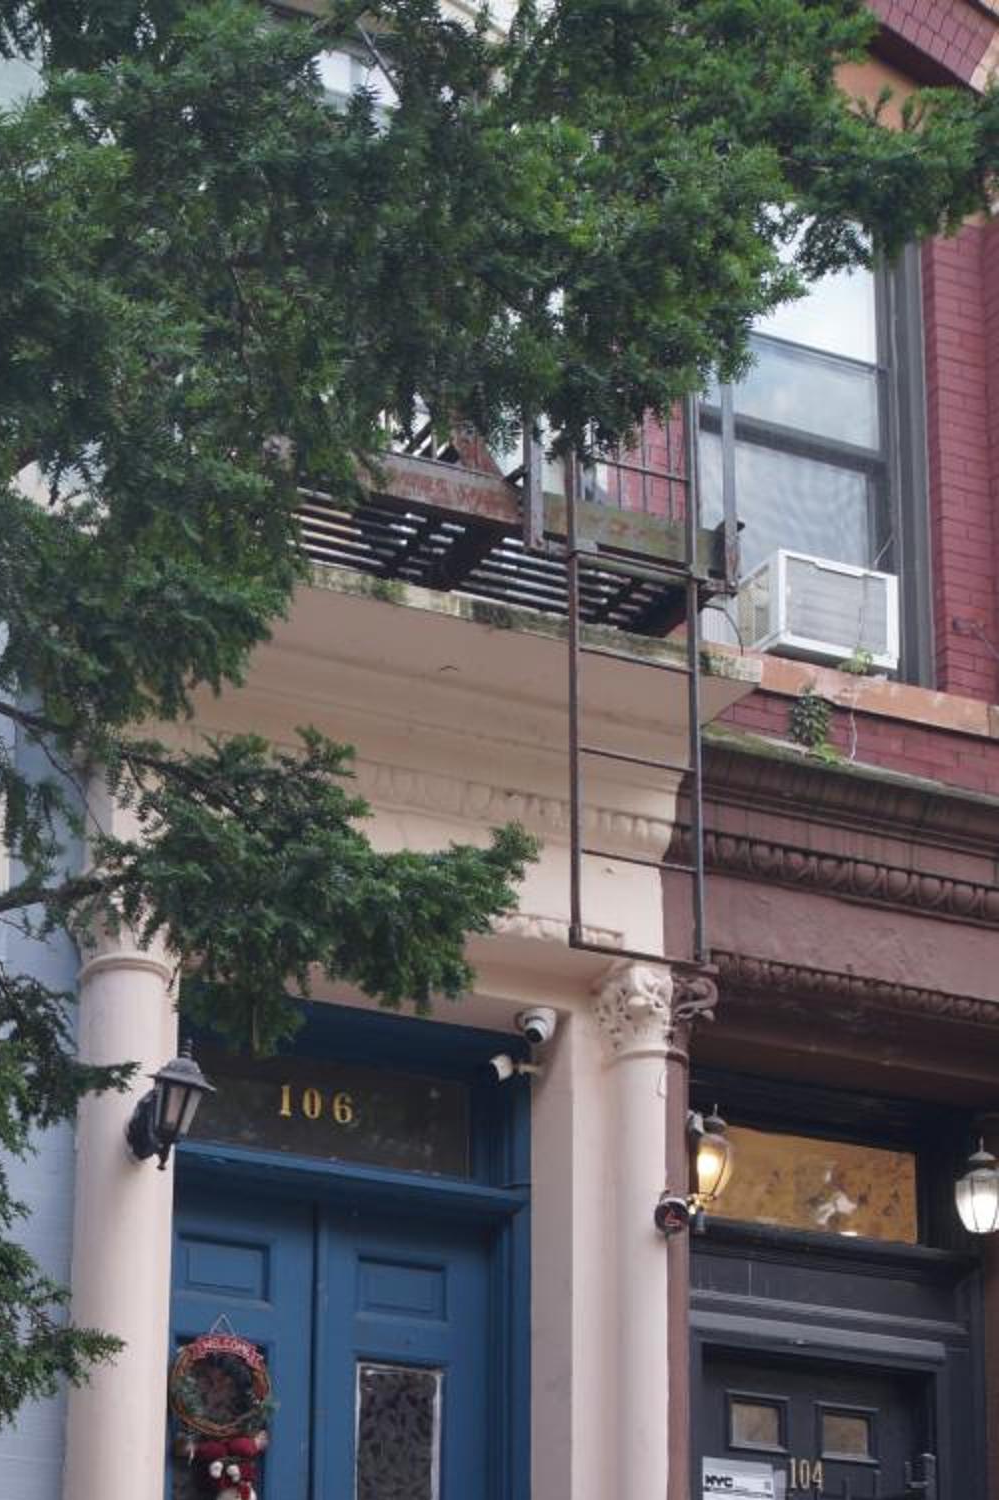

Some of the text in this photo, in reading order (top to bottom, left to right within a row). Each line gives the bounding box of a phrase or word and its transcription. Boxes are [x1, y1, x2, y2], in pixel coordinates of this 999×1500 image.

[280, 1084, 353, 1124] 106
[704, 1475, 734, 1488] NYC
[789, 1457, 825, 1492] 104
